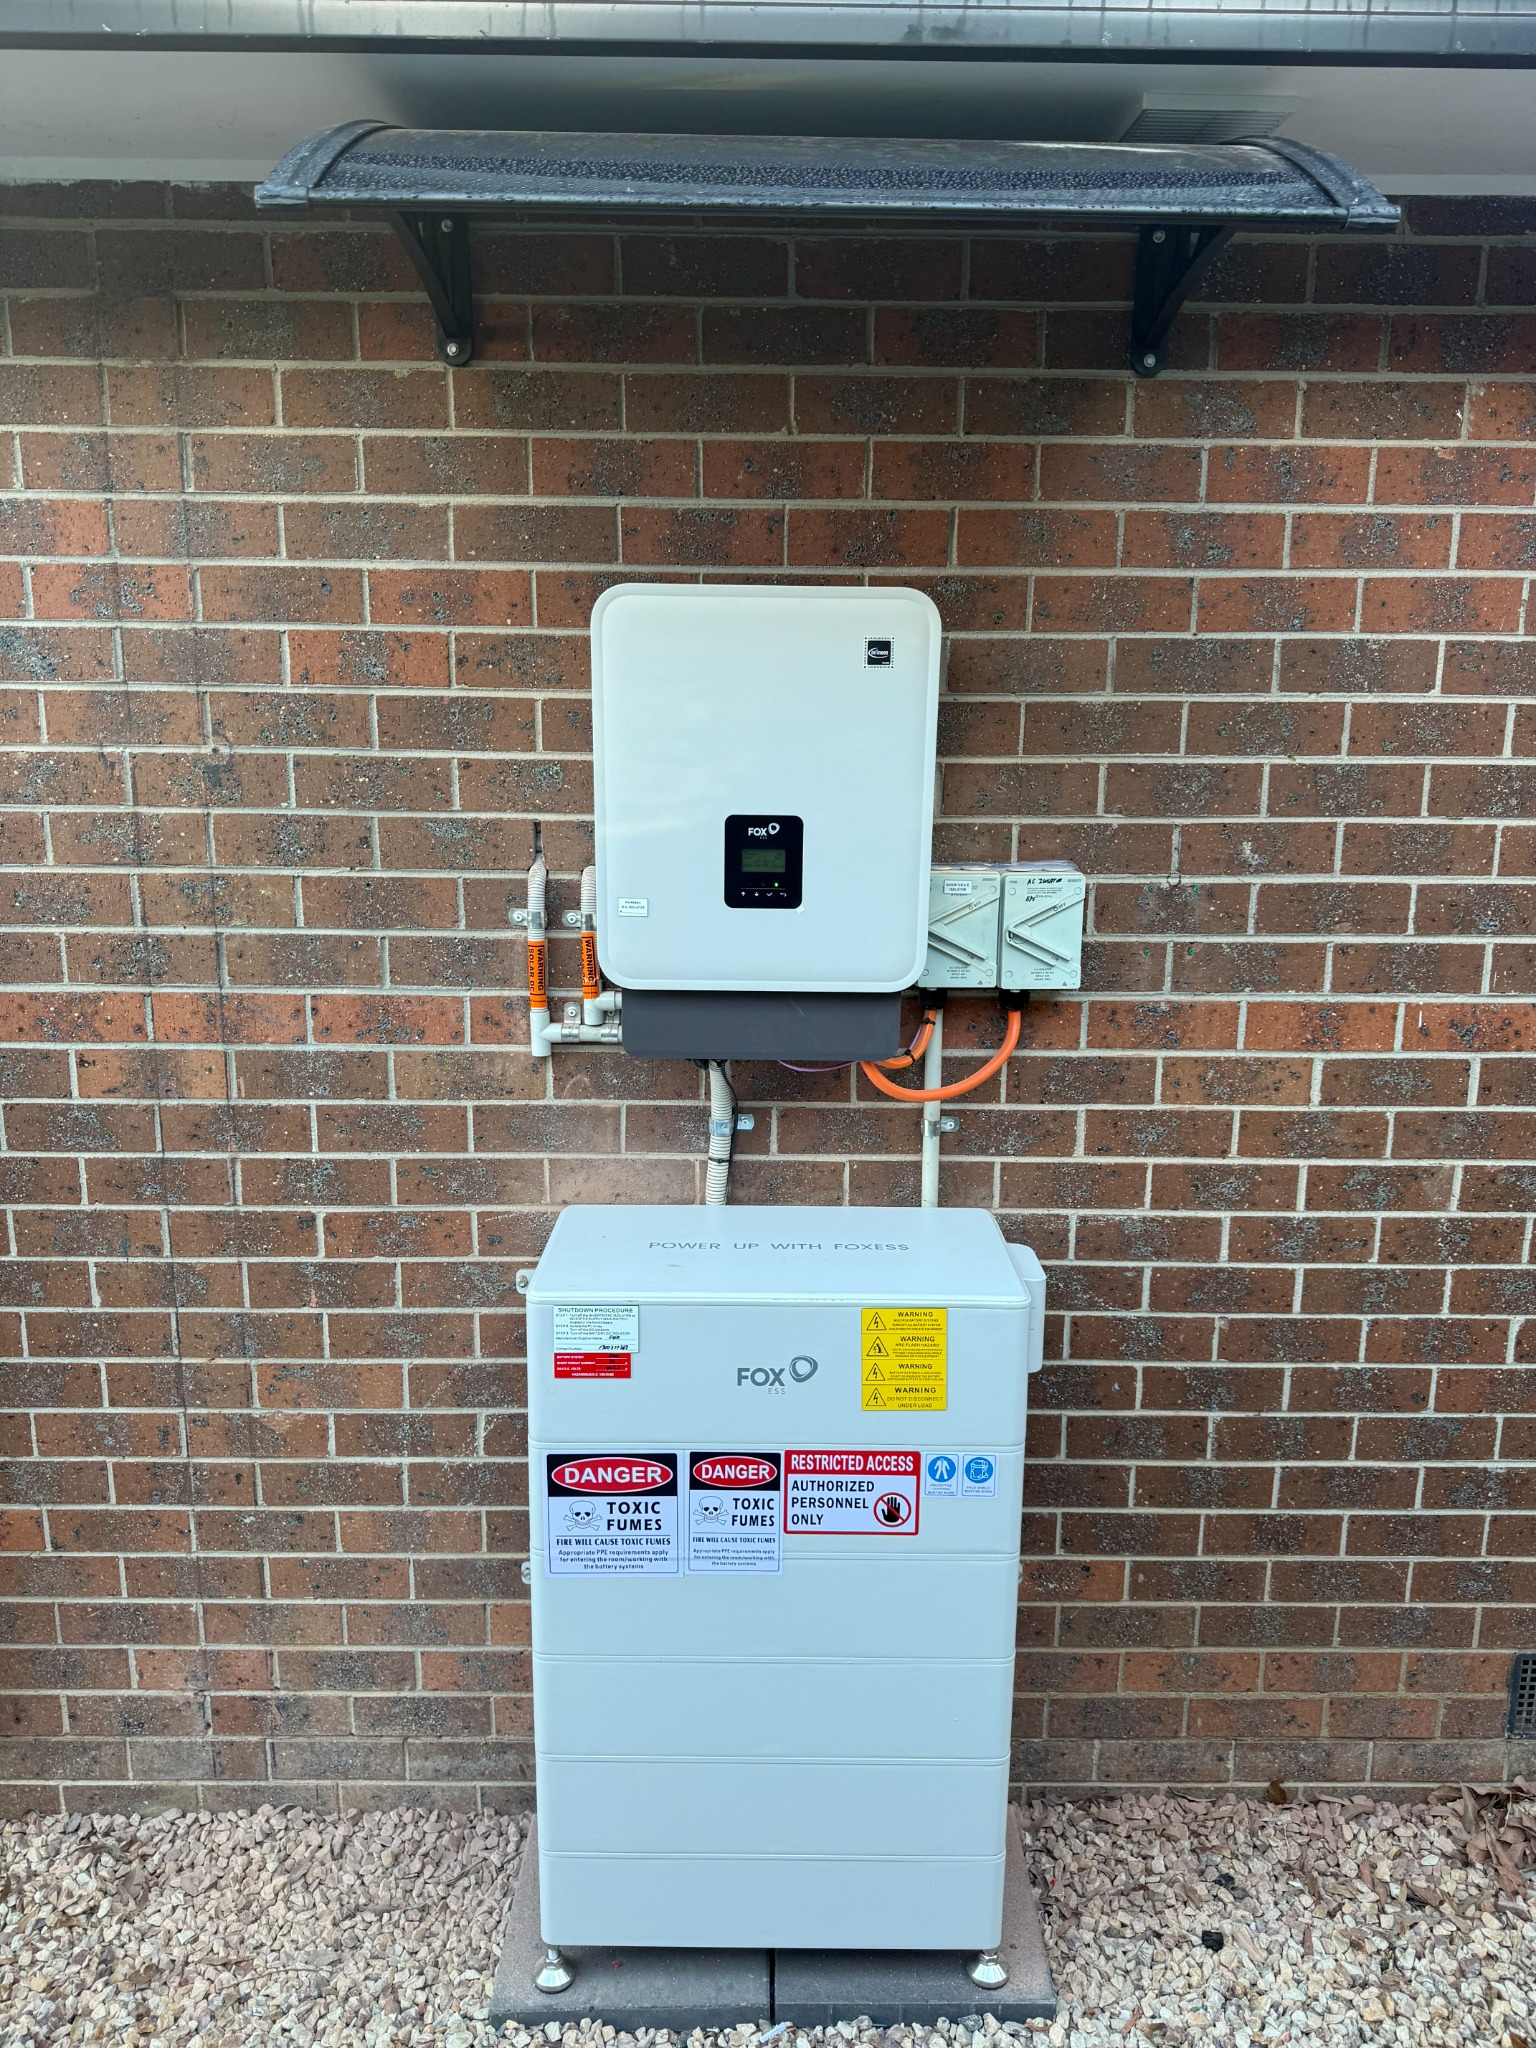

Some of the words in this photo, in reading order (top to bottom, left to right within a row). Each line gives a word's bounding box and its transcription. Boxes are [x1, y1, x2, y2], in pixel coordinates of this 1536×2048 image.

[748, 828, 767, 836] FOX
[585, 939, 594, 982] WARNING
[649, 1242, 721, 1250] POWER
[737, 1368, 786, 1387] FOX
[791, 1454, 864, 1471] RESTRICTED
[866, 1455, 914, 1472] ACCESS
[564, 1467, 663, 1484] DANGER
[701, 1464, 770, 1480] DANGER
[791, 1480, 875, 1492] AUTHORIZED
[607, 1501, 661, 1515] TOXIC
[732, 1498, 775, 1510] TOXIC
[791, 1497, 869, 1509] PERSONNEL
[607, 1518, 662, 1531] FUMES
[732, 1515, 775, 1527] FUMES
[791, 1513, 824, 1525] ONLY
